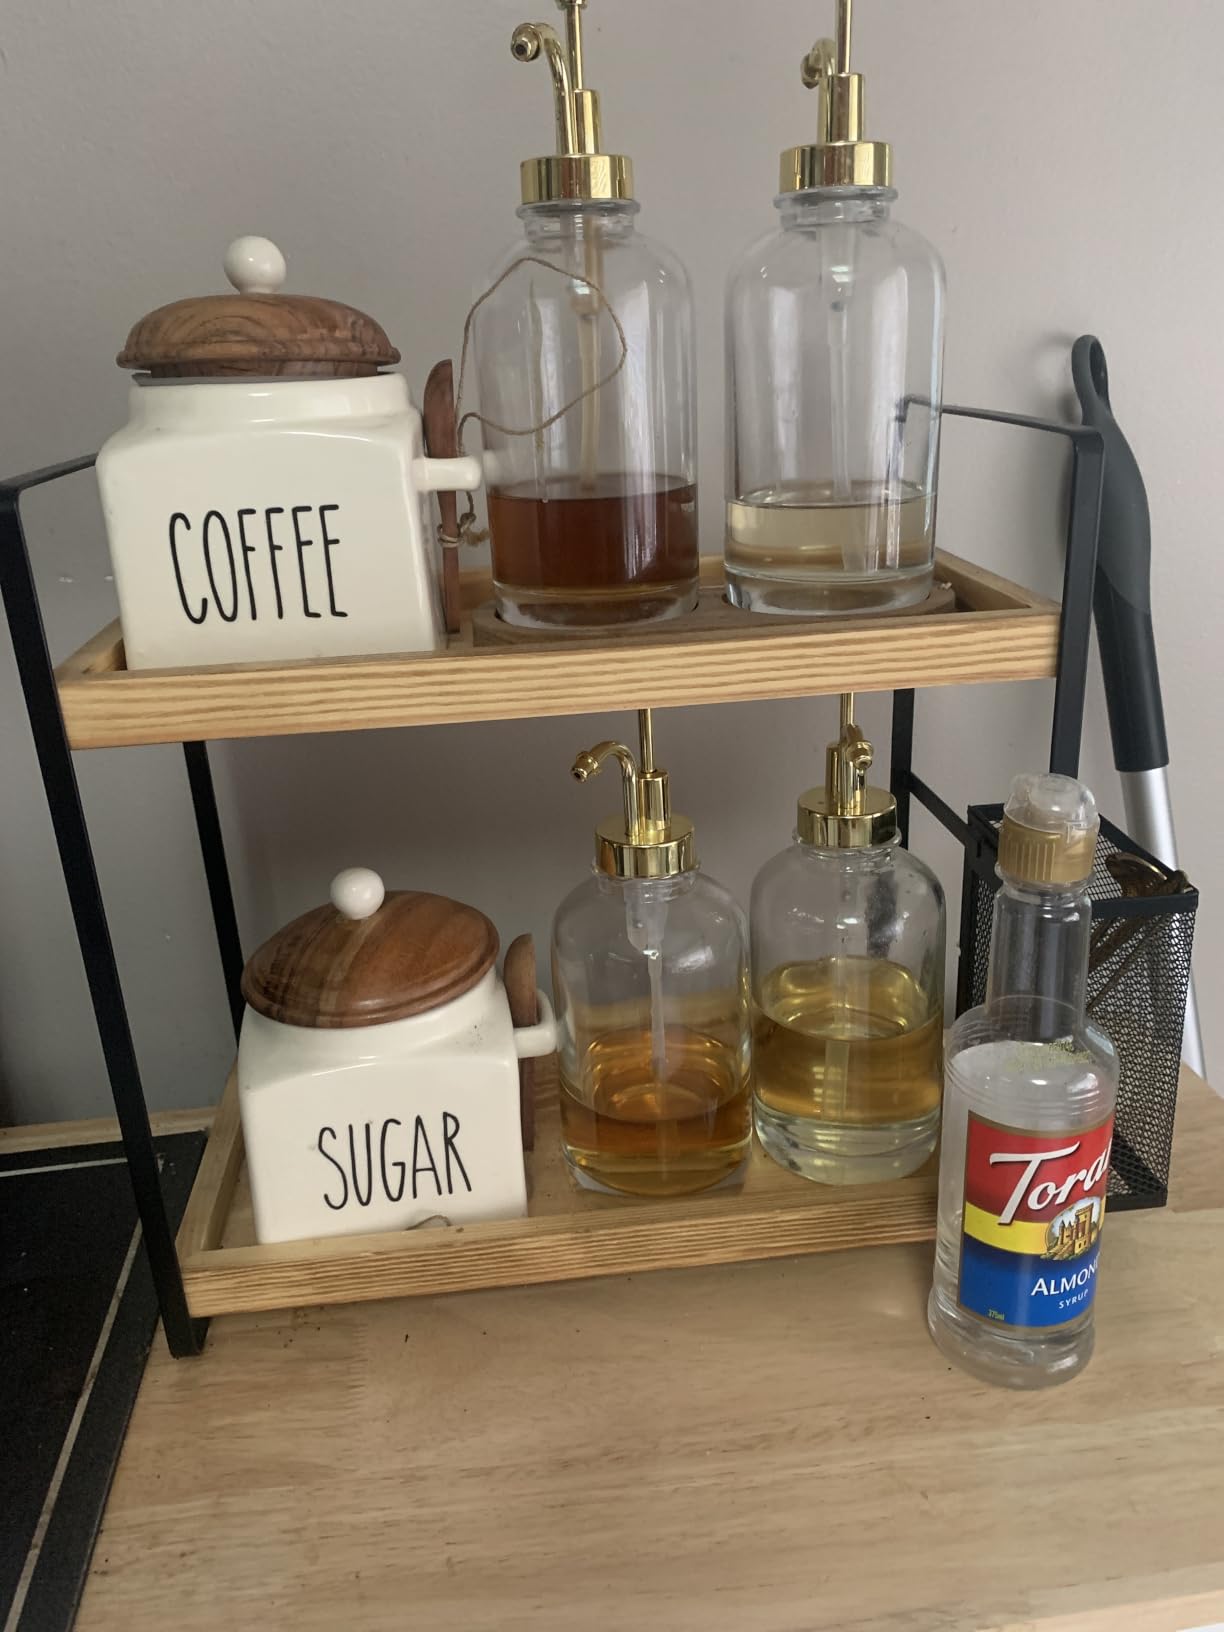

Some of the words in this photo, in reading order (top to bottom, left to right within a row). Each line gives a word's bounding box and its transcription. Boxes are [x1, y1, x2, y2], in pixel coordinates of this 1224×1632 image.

[168, 504, 348, 625] COFFEE
[318, 1111, 472, 1210] SUGAR
[1058, 1288, 1089, 1309] SYRUP
